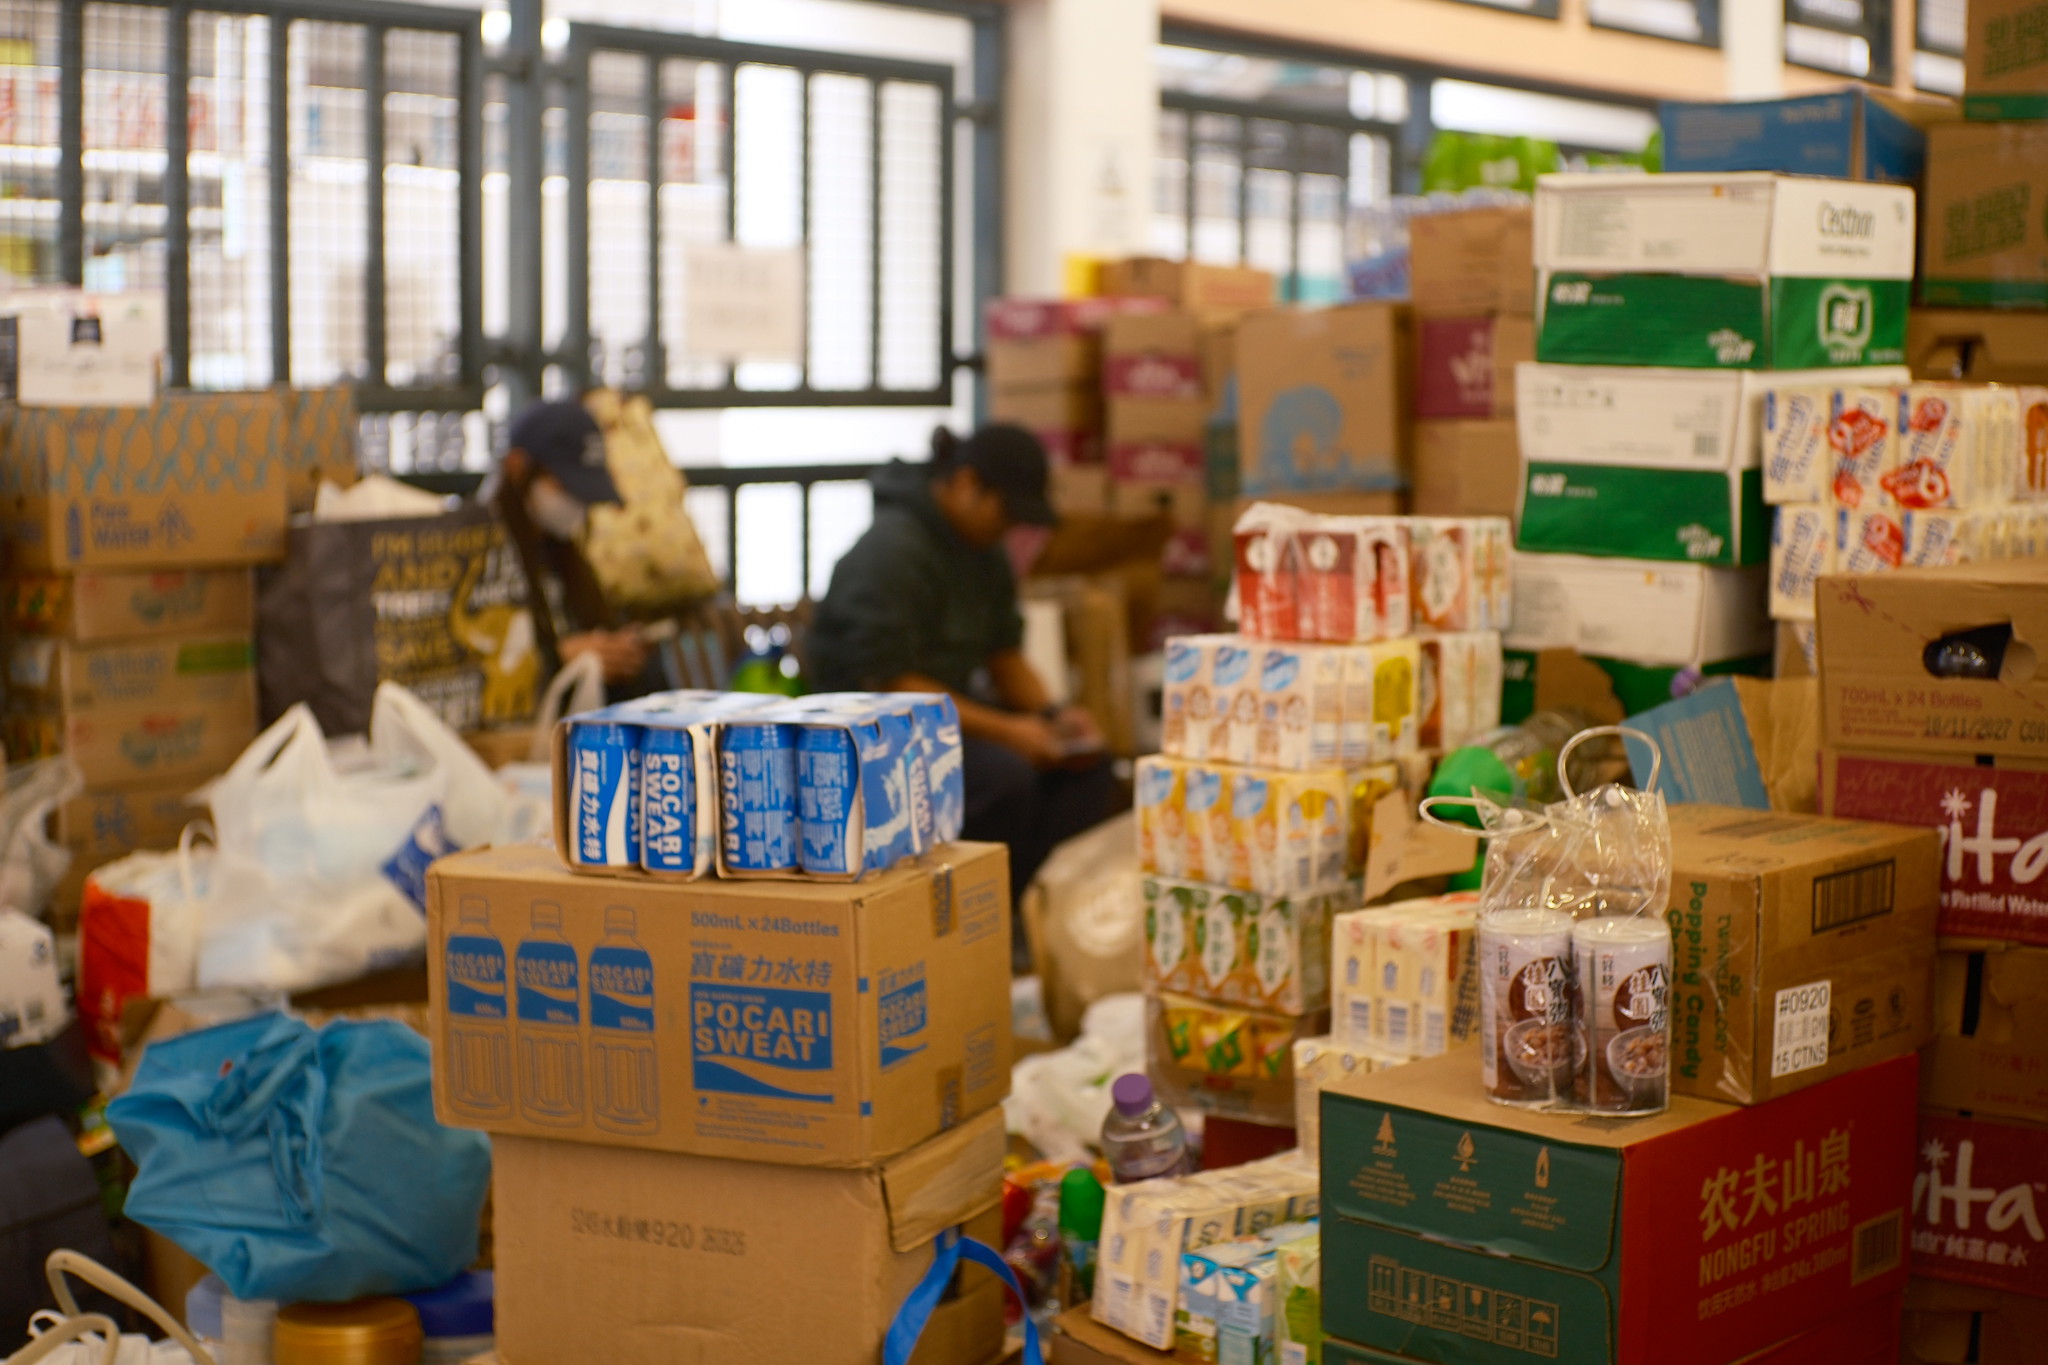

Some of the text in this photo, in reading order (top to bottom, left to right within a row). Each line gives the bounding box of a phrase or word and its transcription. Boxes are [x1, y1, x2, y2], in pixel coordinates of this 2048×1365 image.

[1929, 689, 1984, 710] Bottles
[645, 753, 663, 856] SWEAT
[661, 753, 683, 866] POCARI
[721, 751, 741, 864] POCARI
[691, 911, 744, 931] 500mL
[447, 952, 503, 970] POCARI
[448, 964, 497, 981] SWEAT
[516, 957, 576, 975] POCARI
[590, 963, 652, 982] POCARI
[516, 970, 570, 987] SWEAT
[591, 976, 646, 994] SWEAT
[1680, 881, 1708, 1080] Popping Candy
[1779, 985, 1830, 1016] #0920
[693, 1000, 829, 1038] POCARI
[694, 1026, 817, 1062] SWEAT
[1775, 1041, 1828, 1074] 15 CTNS
[1699, 1127, 1852, 1243] 农夫山泉
[1699, 1200, 1850, 1288] NONGFU SPRING
